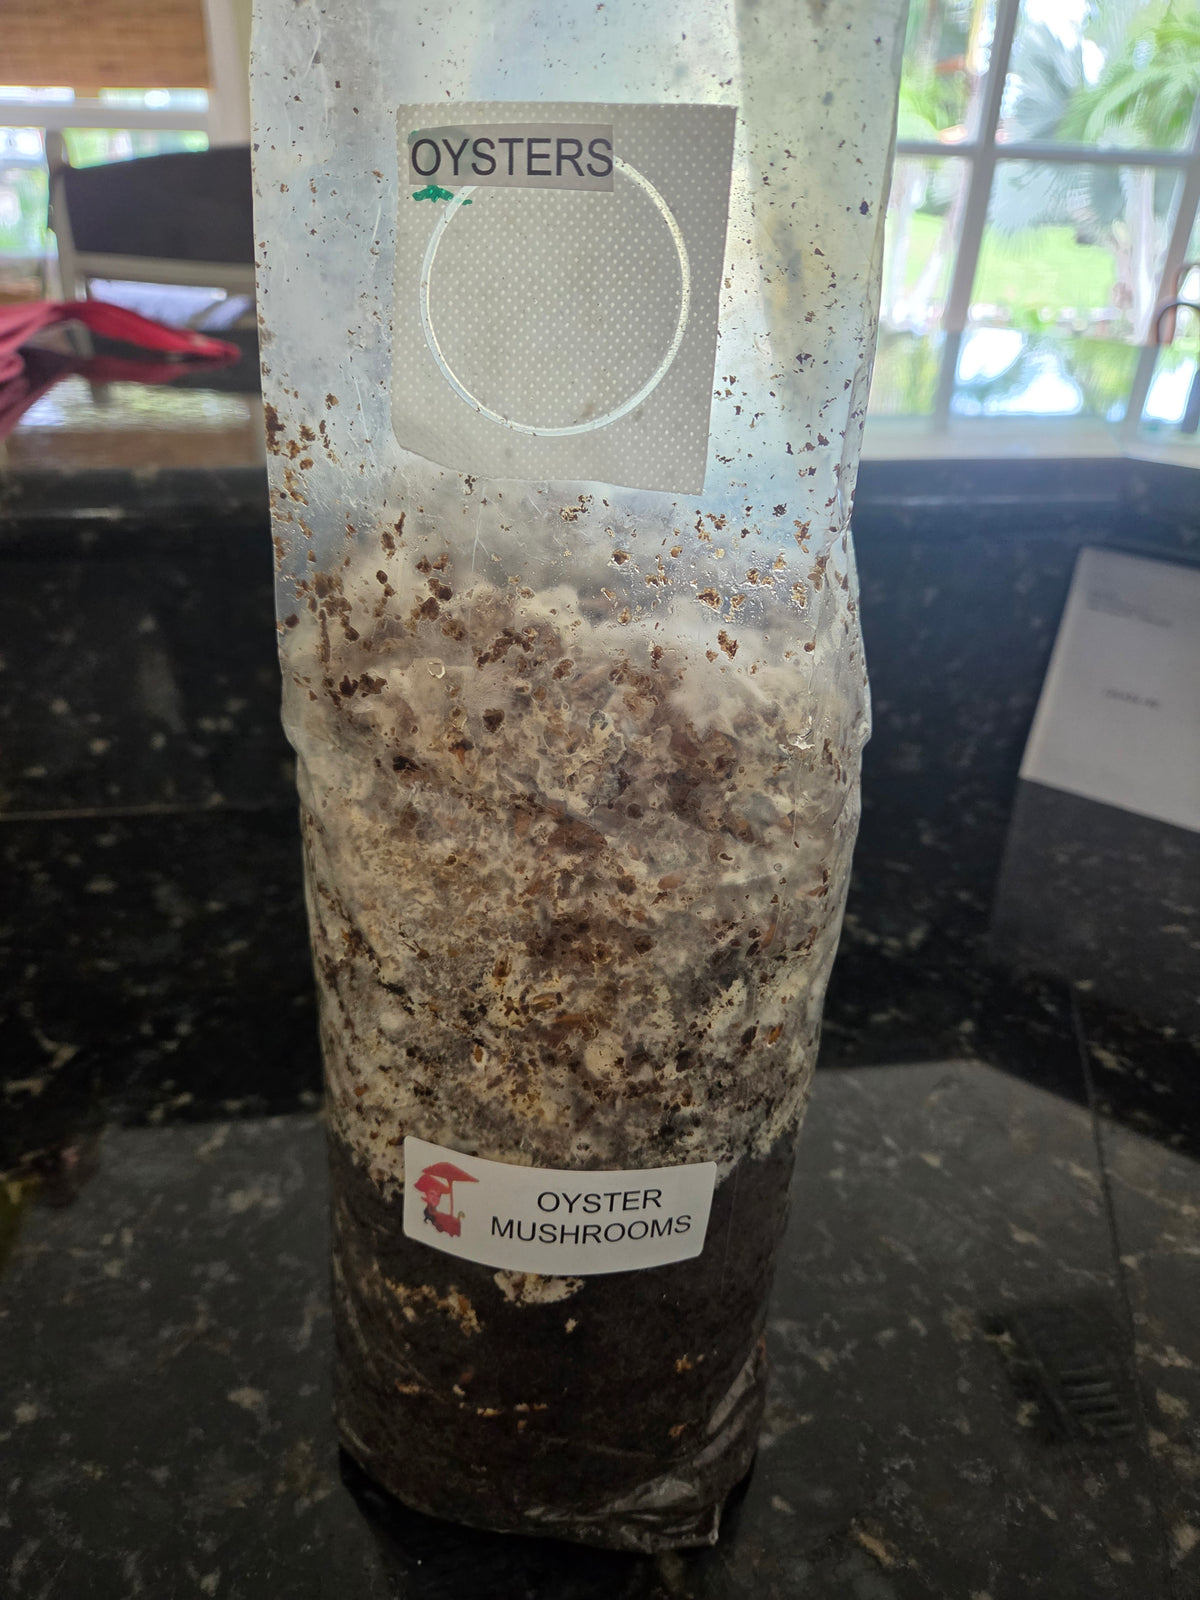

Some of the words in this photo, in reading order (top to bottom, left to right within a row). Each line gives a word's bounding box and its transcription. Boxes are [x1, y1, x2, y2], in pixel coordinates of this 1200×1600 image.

[411, 137, 613, 178] OYSTERS
[537, 1188, 662, 1214] OYSTER
[491, 1214, 692, 1245] MUSHROOMS
